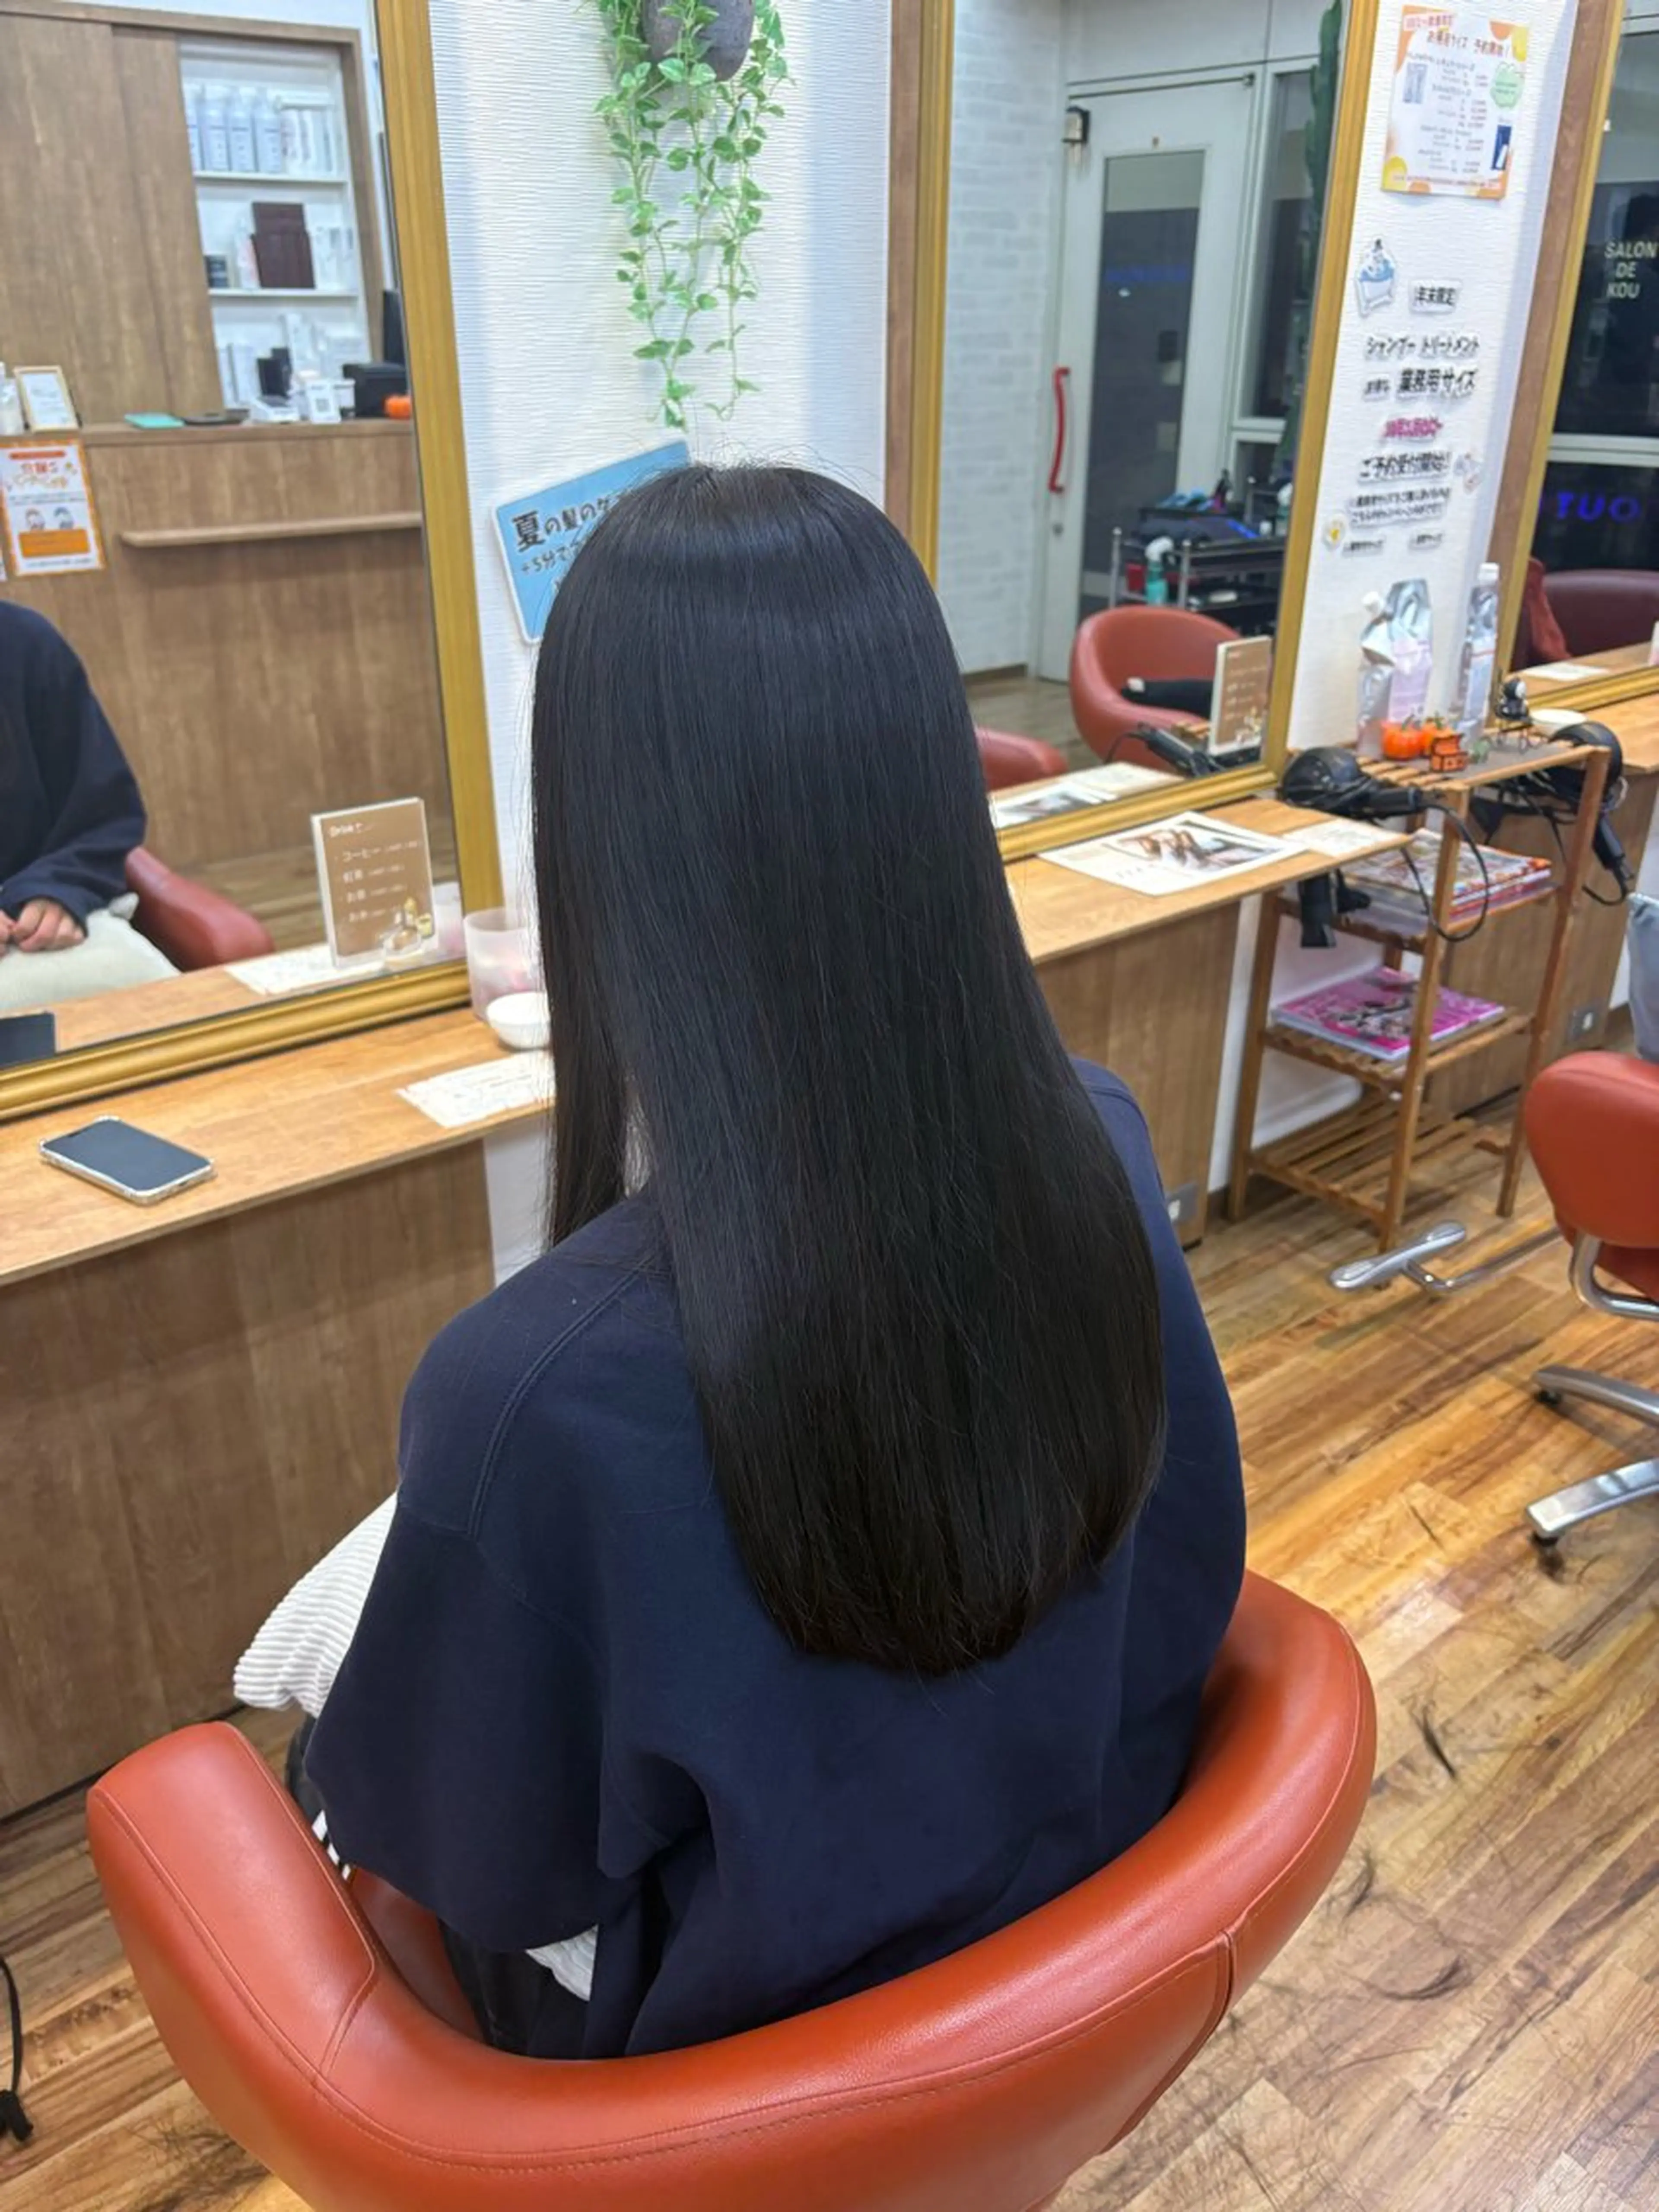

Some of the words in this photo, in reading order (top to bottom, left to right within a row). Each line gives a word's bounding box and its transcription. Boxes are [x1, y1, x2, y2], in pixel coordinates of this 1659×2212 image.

[1605, 242, 1659, 258] SALON
[1616, 262, 1637, 278] DE
[1607, 282, 1640, 299] KOU
